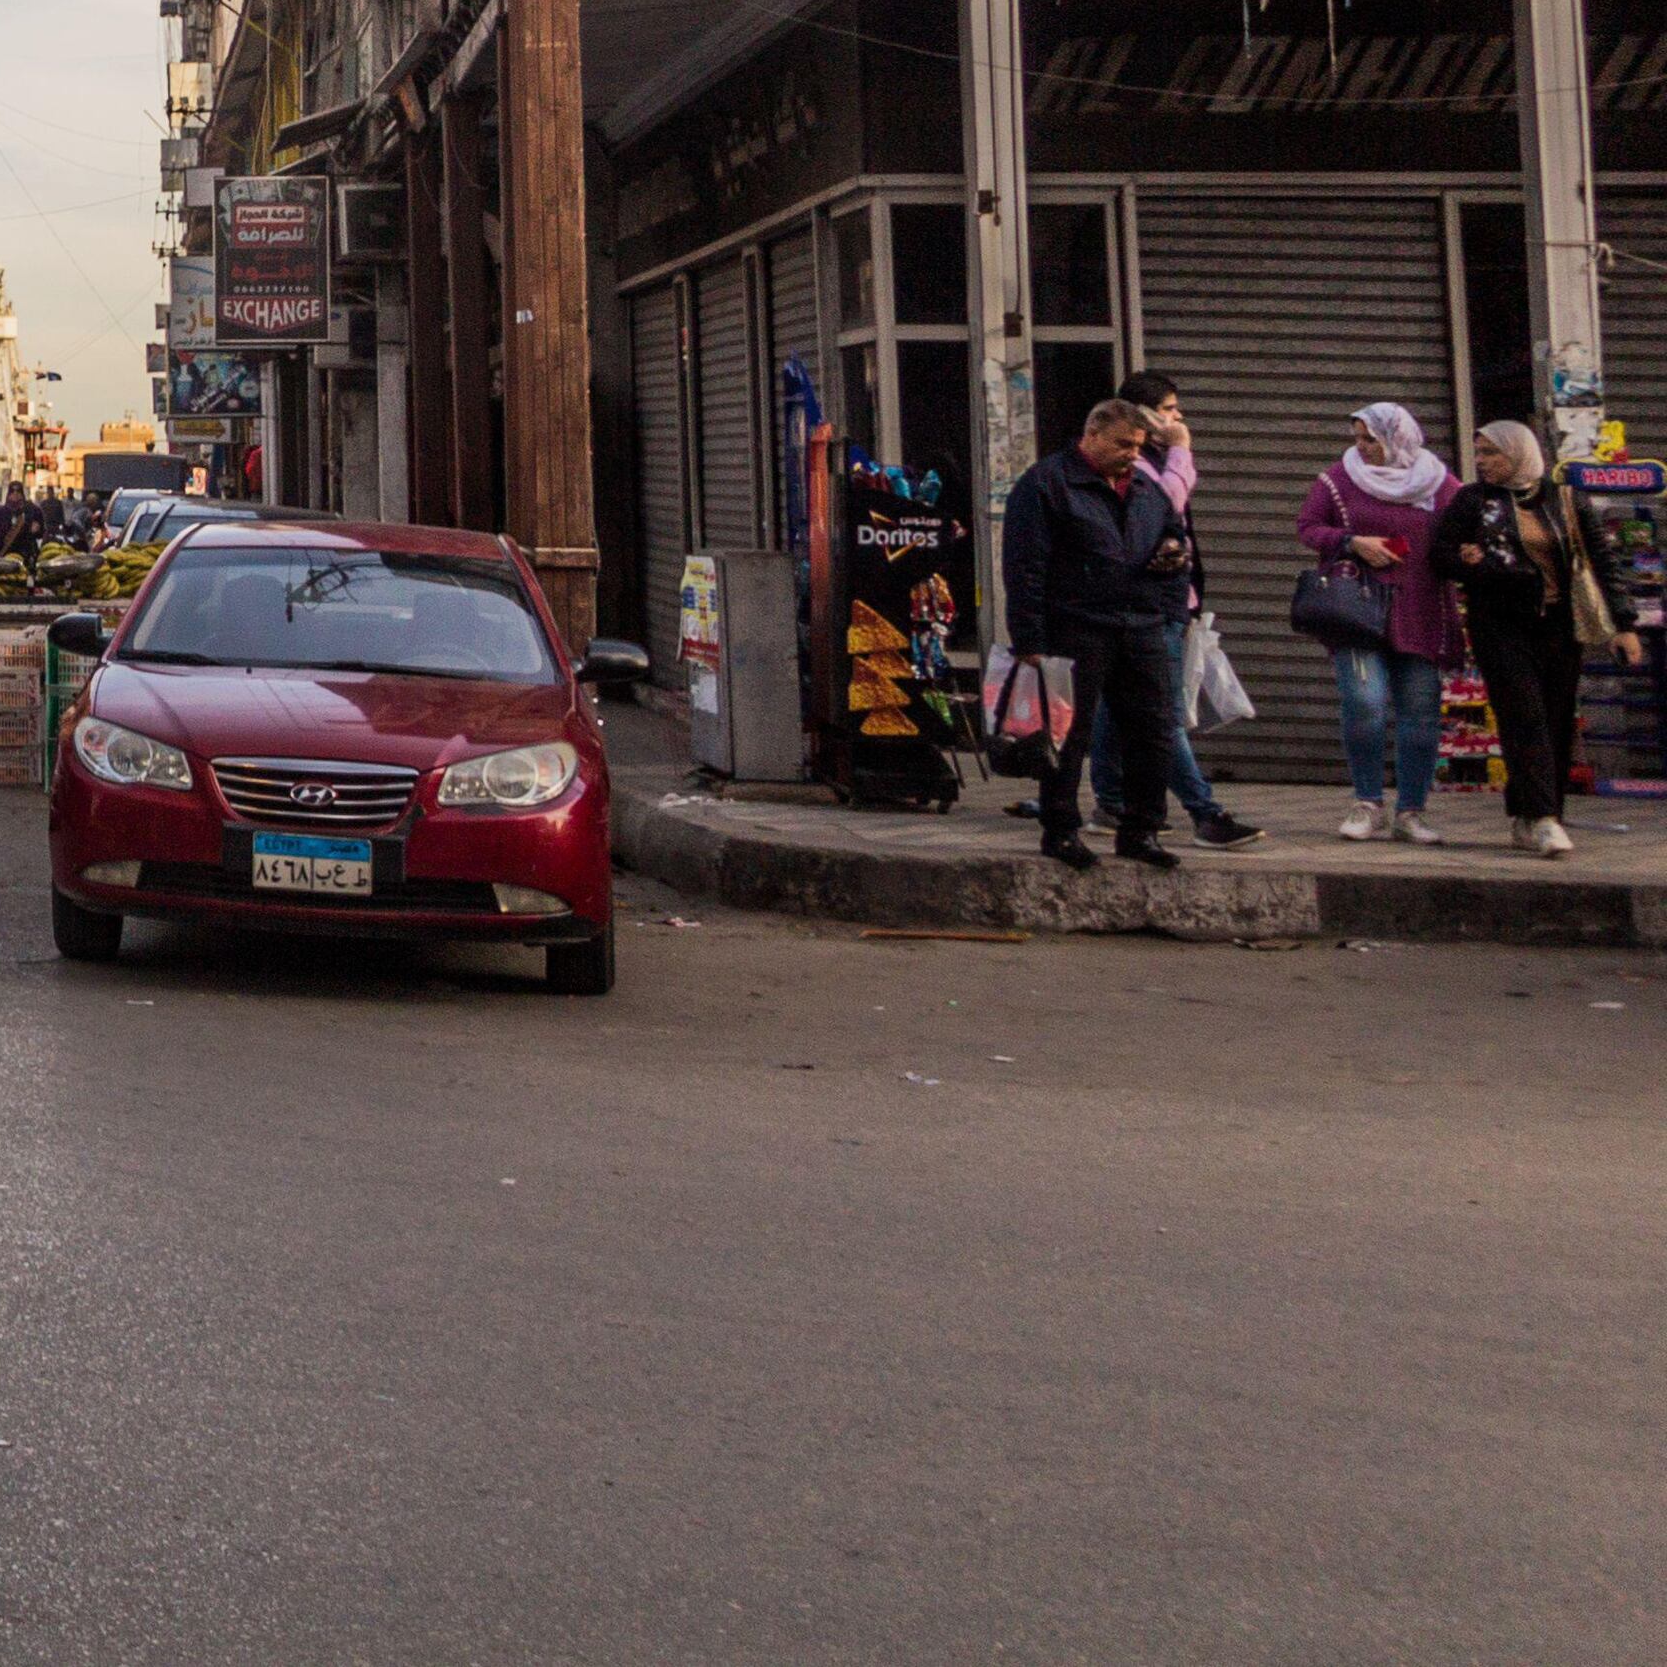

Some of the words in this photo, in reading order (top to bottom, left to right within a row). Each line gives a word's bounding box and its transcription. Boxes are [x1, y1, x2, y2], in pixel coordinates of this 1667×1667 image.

[223, 298, 322, 331] EXCHANGE
[1582, 468, 1652, 487] HARIBO
[857, 524, 940, 547] Doritos
[256, 859, 309, 884] ٨٤٦٨
